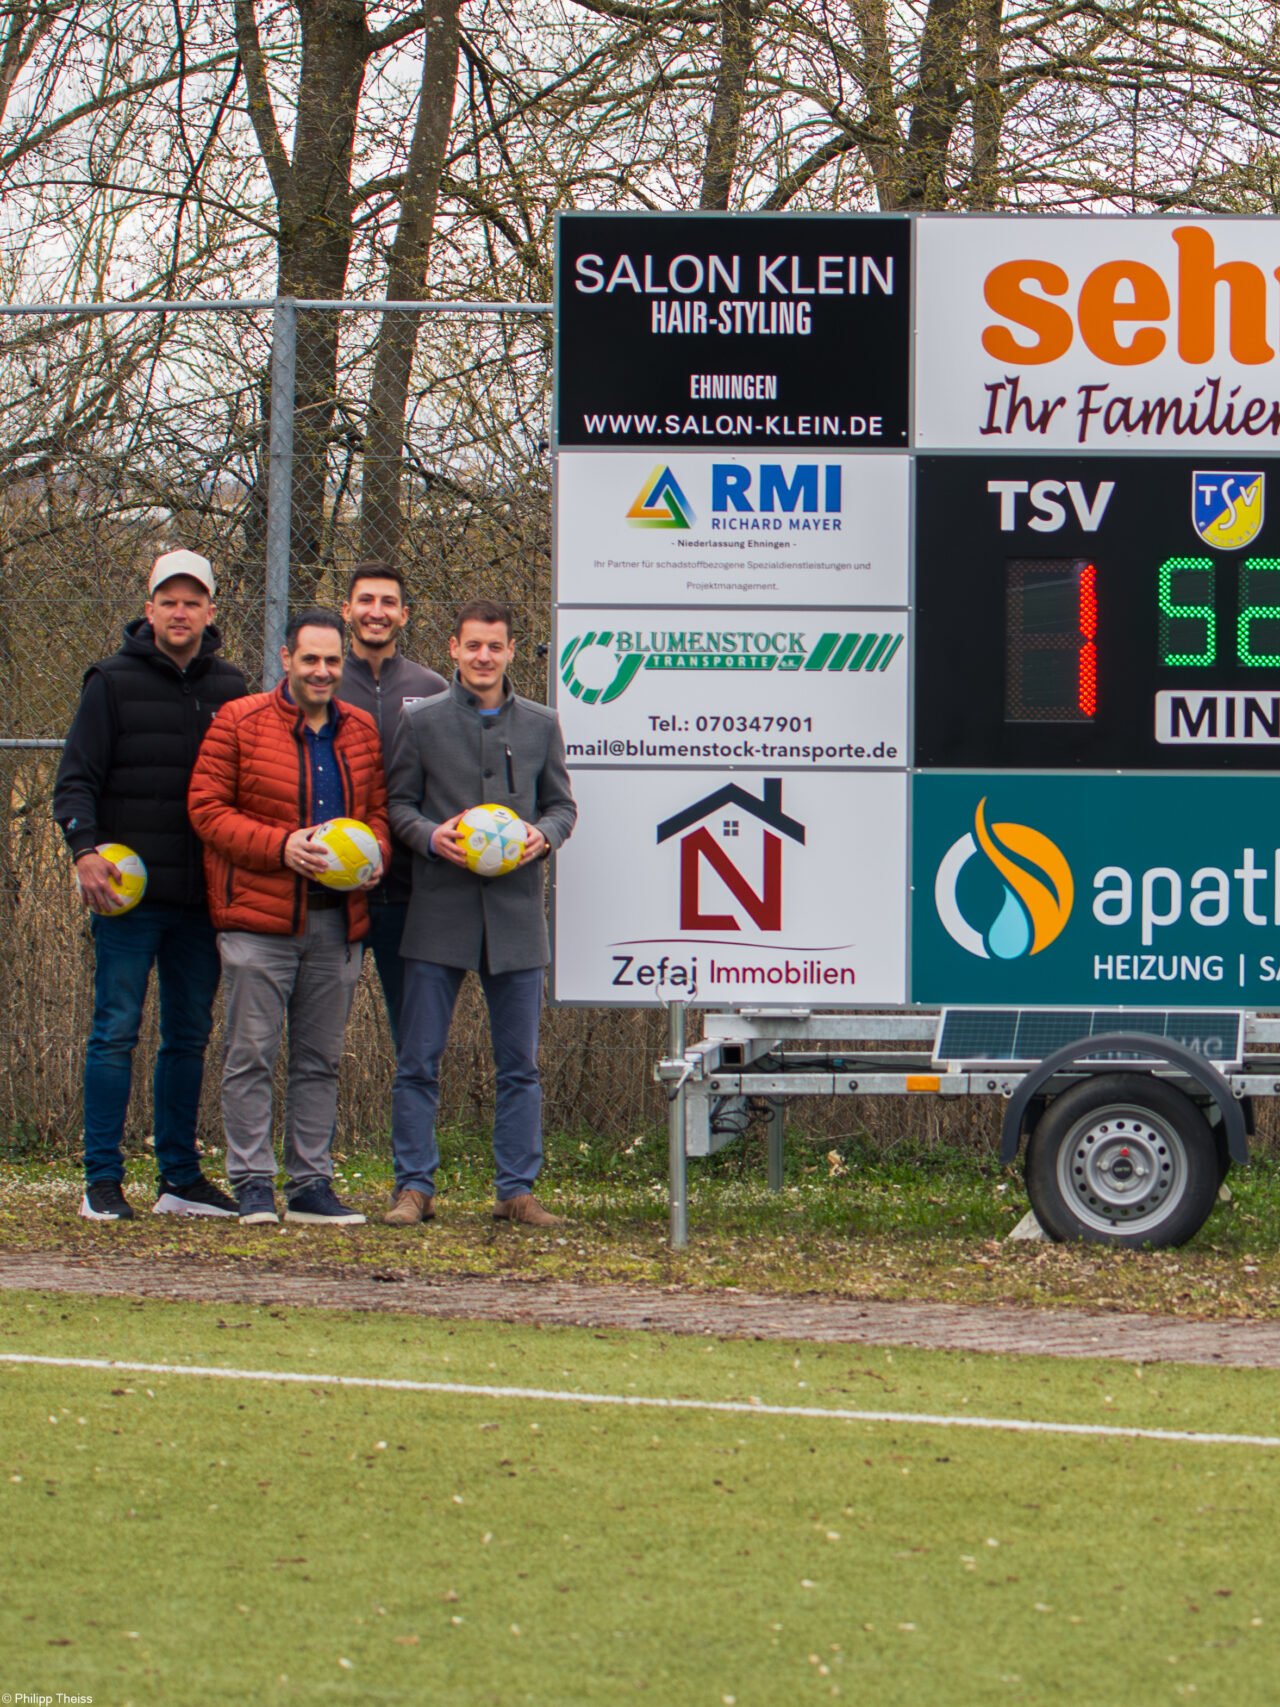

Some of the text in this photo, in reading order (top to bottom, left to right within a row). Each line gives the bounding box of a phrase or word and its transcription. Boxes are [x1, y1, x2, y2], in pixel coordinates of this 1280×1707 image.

[574, 253, 894, 295] SALON KLEIN
[652, 301, 812, 335] HAIR-STYLING
[690, 375, 777, 400] EHNINGEN
[979, 375, 1066, 435] Ihr
[584, 414, 883, 436] WWW.SALON-KLEIN.DE
[712, 463, 842, 513] RMI
[988, 481, 1115, 533] TSV
[1198, 477, 1258, 530] TSV
[712, 518, 842, 531] RICHARD MAYER
[677, 539, 790, 550] Niederlassung Ehningen
[607, 560, 640, 568] Partner
[642, 560, 654, 569] für
[854, 562, 871, 570] und
[616, 631, 808, 653] BLUMENSTOCK
[1078, 563, 1098, 717] 1
[652, 656, 769, 667] TRANSPORTE
[649, 715, 813, 732] Tel.: 070347901
[566, 740, 897, 762] mail@blumenstock-transporte.de
[612, 955, 856, 994] Zefaj Immobilien
[1094, 955, 1224, 981] HEIZUNG
